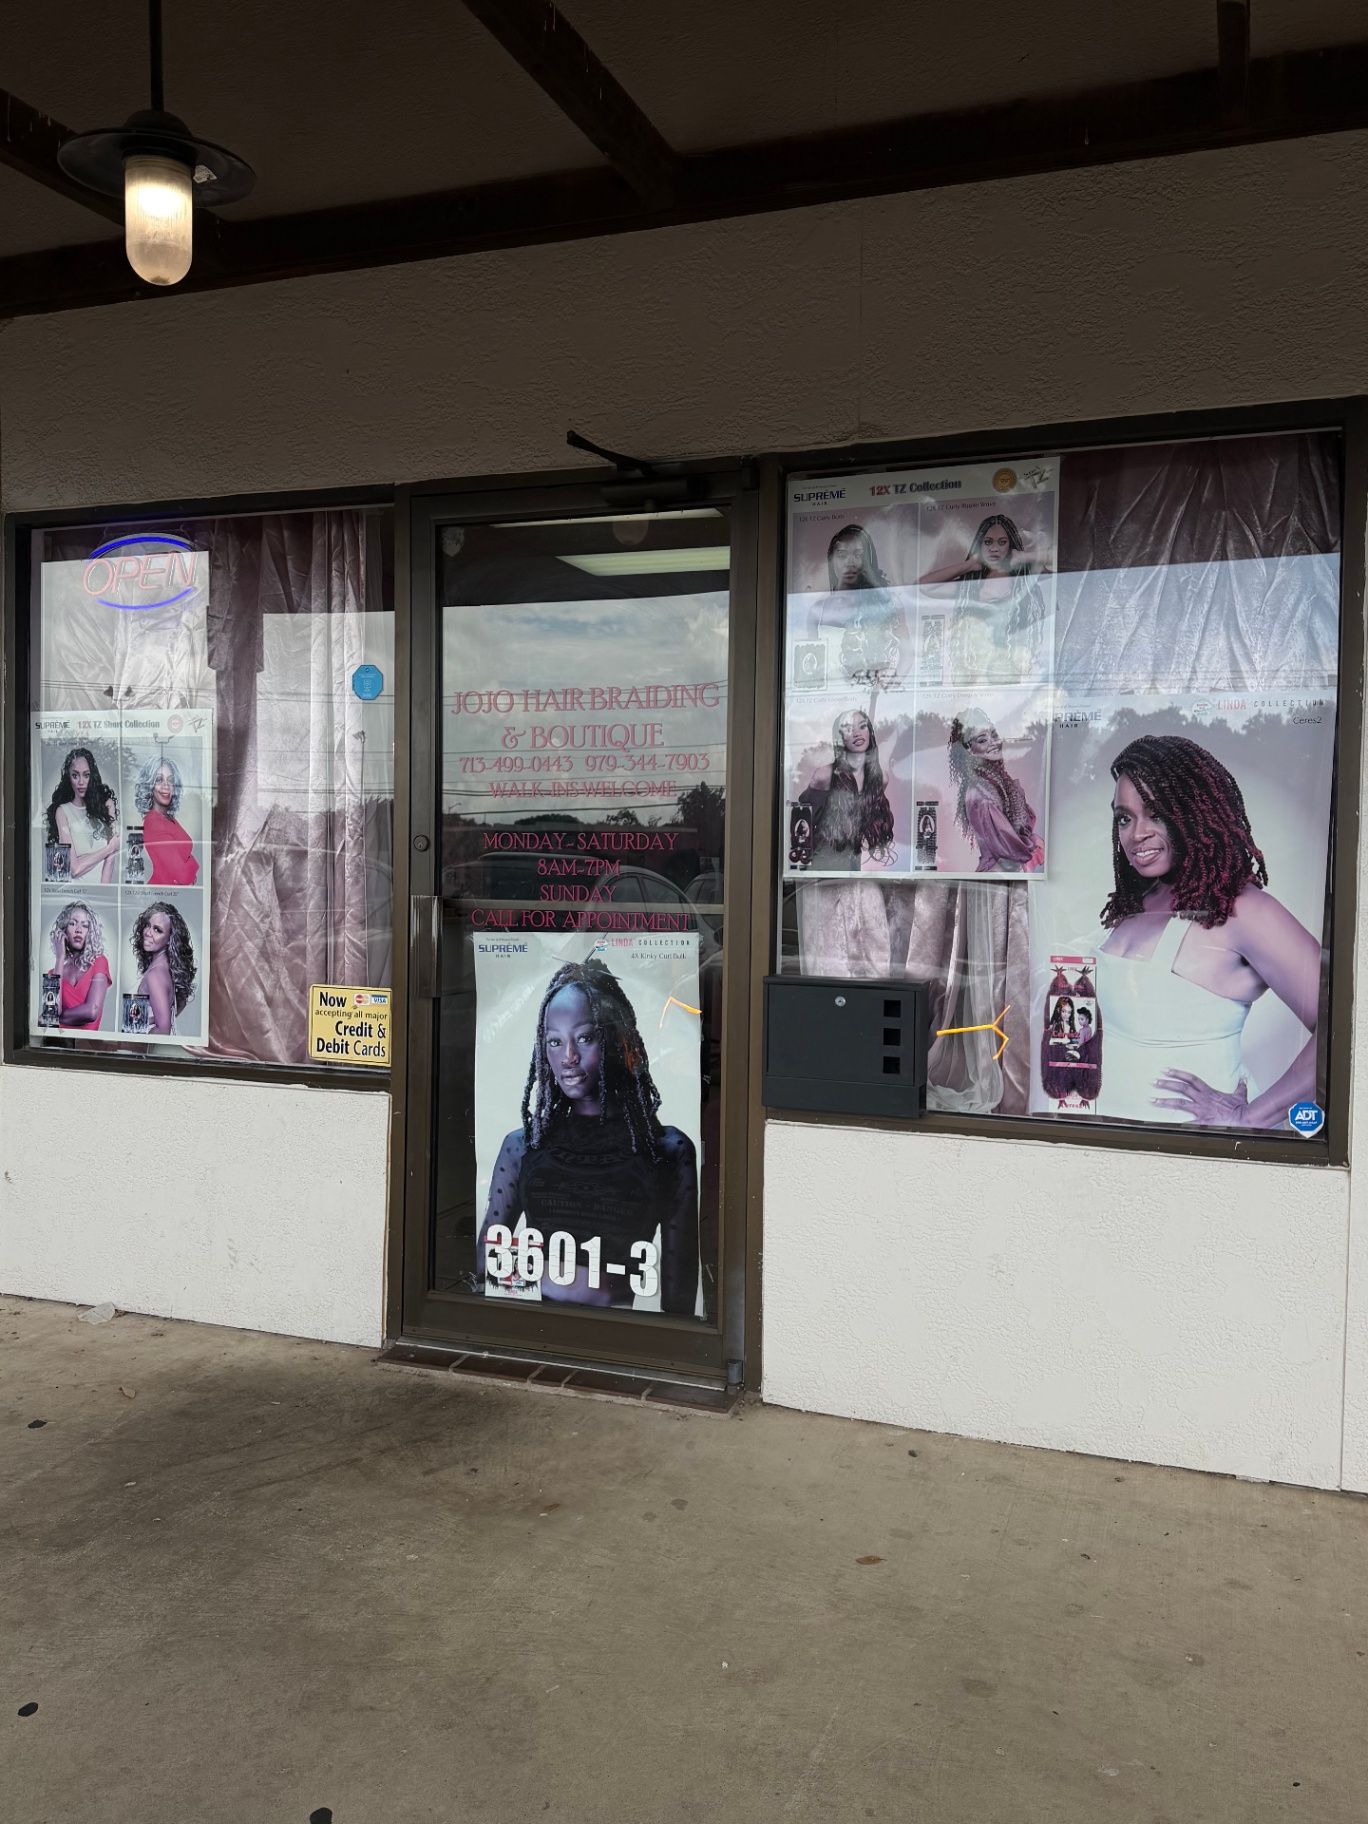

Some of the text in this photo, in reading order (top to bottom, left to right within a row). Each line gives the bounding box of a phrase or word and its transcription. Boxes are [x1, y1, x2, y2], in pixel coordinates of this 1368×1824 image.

[870, 480, 962, 496] 12X TZ Collection
[82, 551, 196, 595] OPEN
[452, 683, 720, 714] JOJO HAIR BRAIDING
[1218, 700, 1246, 710] LINDA
[78, 720, 160, 729] 12X TZ Short Collection
[1293, 716, 1322, 725] Ceres2
[501, 723, 665, 752] & BOUTIQUE
[459, 753, 711, 773] 713-499-0443 979-344-7903
[489, 780, 677, 799] WALK-INS WELCOME
[536, 859, 621, 877] 8AM-7PM
[540, 885, 617, 903] SUNDAY
[471, 909, 690, 931] CALL FOR APPOINTMENT
[611, 938, 634, 947] LINDA
[640, 952, 658, 961] Kinky
[320, 992, 347, 1008] Now
[315, 1009, 387, 1021] accepting all major
[335, 1020, 386, 1039] Credit &
[317, 1037, 386, 1057] Debit Cards
[1295, 1110, 1318, 1121] ADT
[486, 1224, 659, 1297] 3601-3
